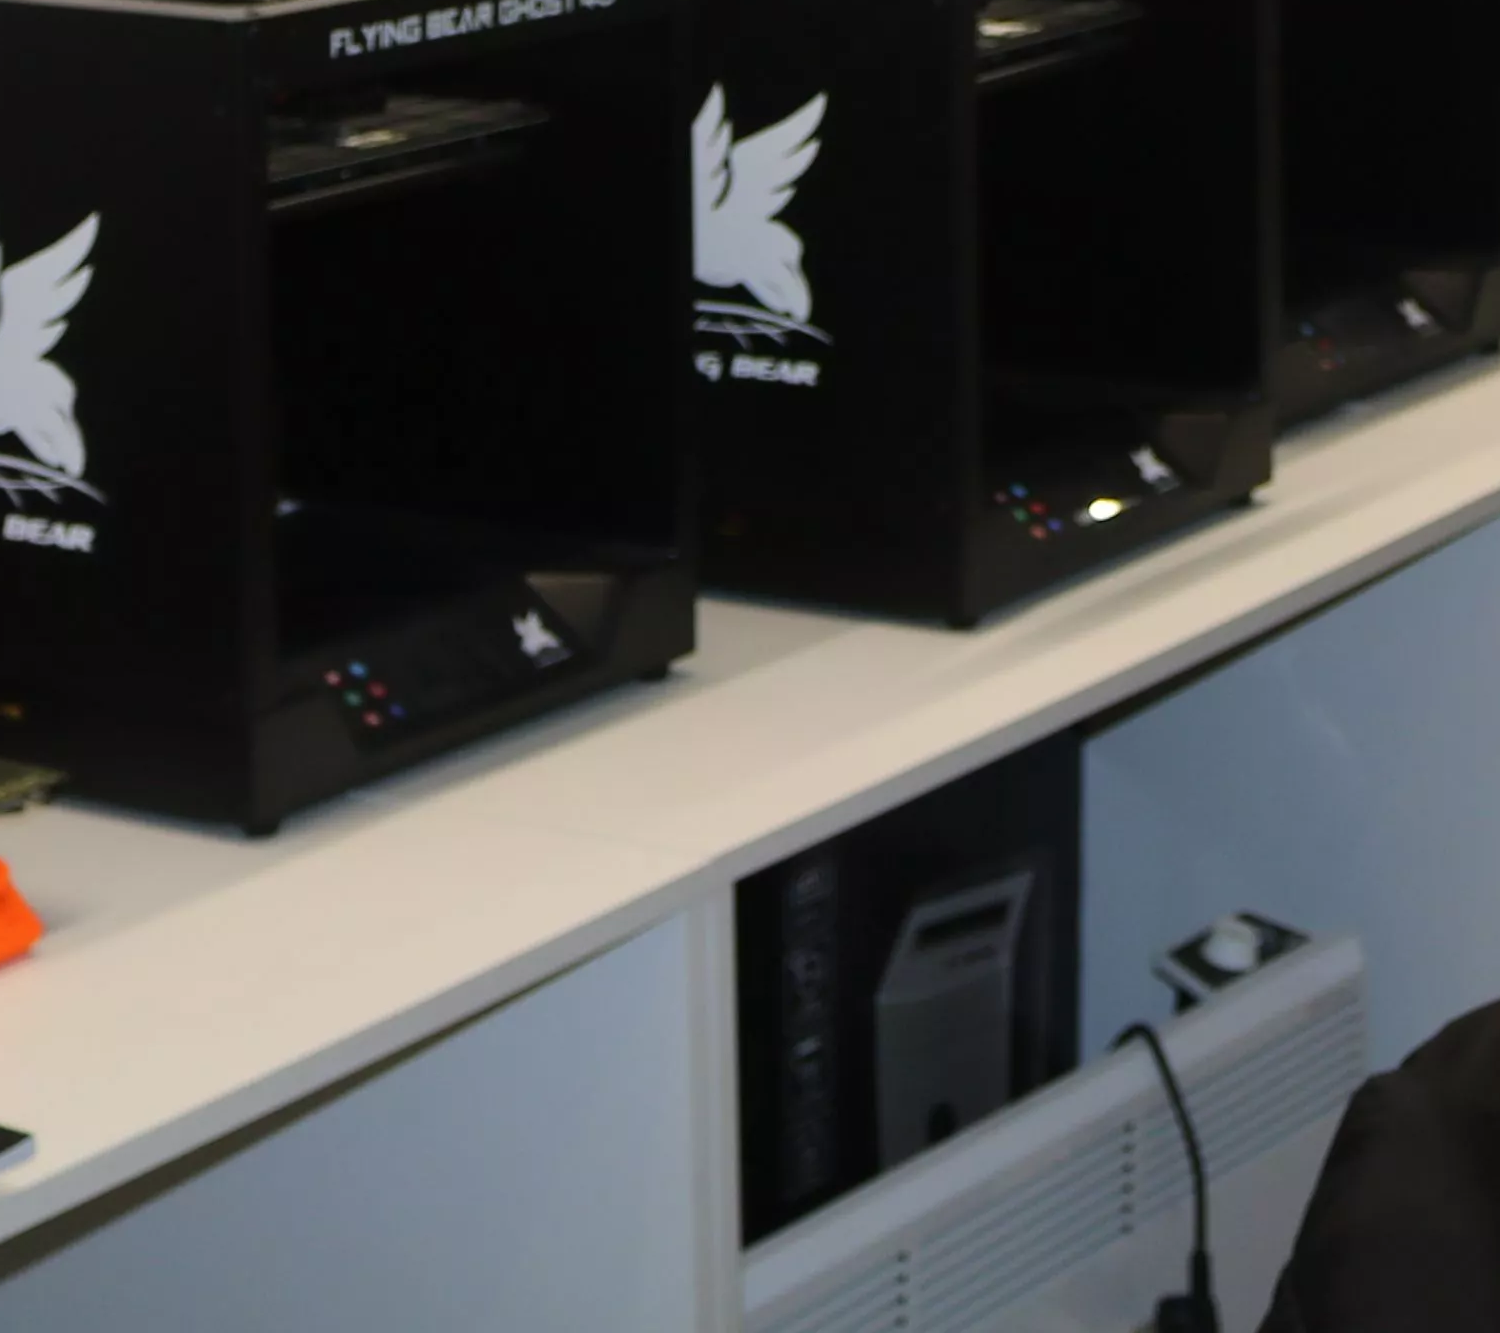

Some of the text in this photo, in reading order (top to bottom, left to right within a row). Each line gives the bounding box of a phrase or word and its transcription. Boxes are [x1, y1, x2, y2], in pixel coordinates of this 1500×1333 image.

[329, 14, 422, 59] FLYING
[424, 0, 496, 41] BEAR
[2, 513, 97, 553] BEAR
